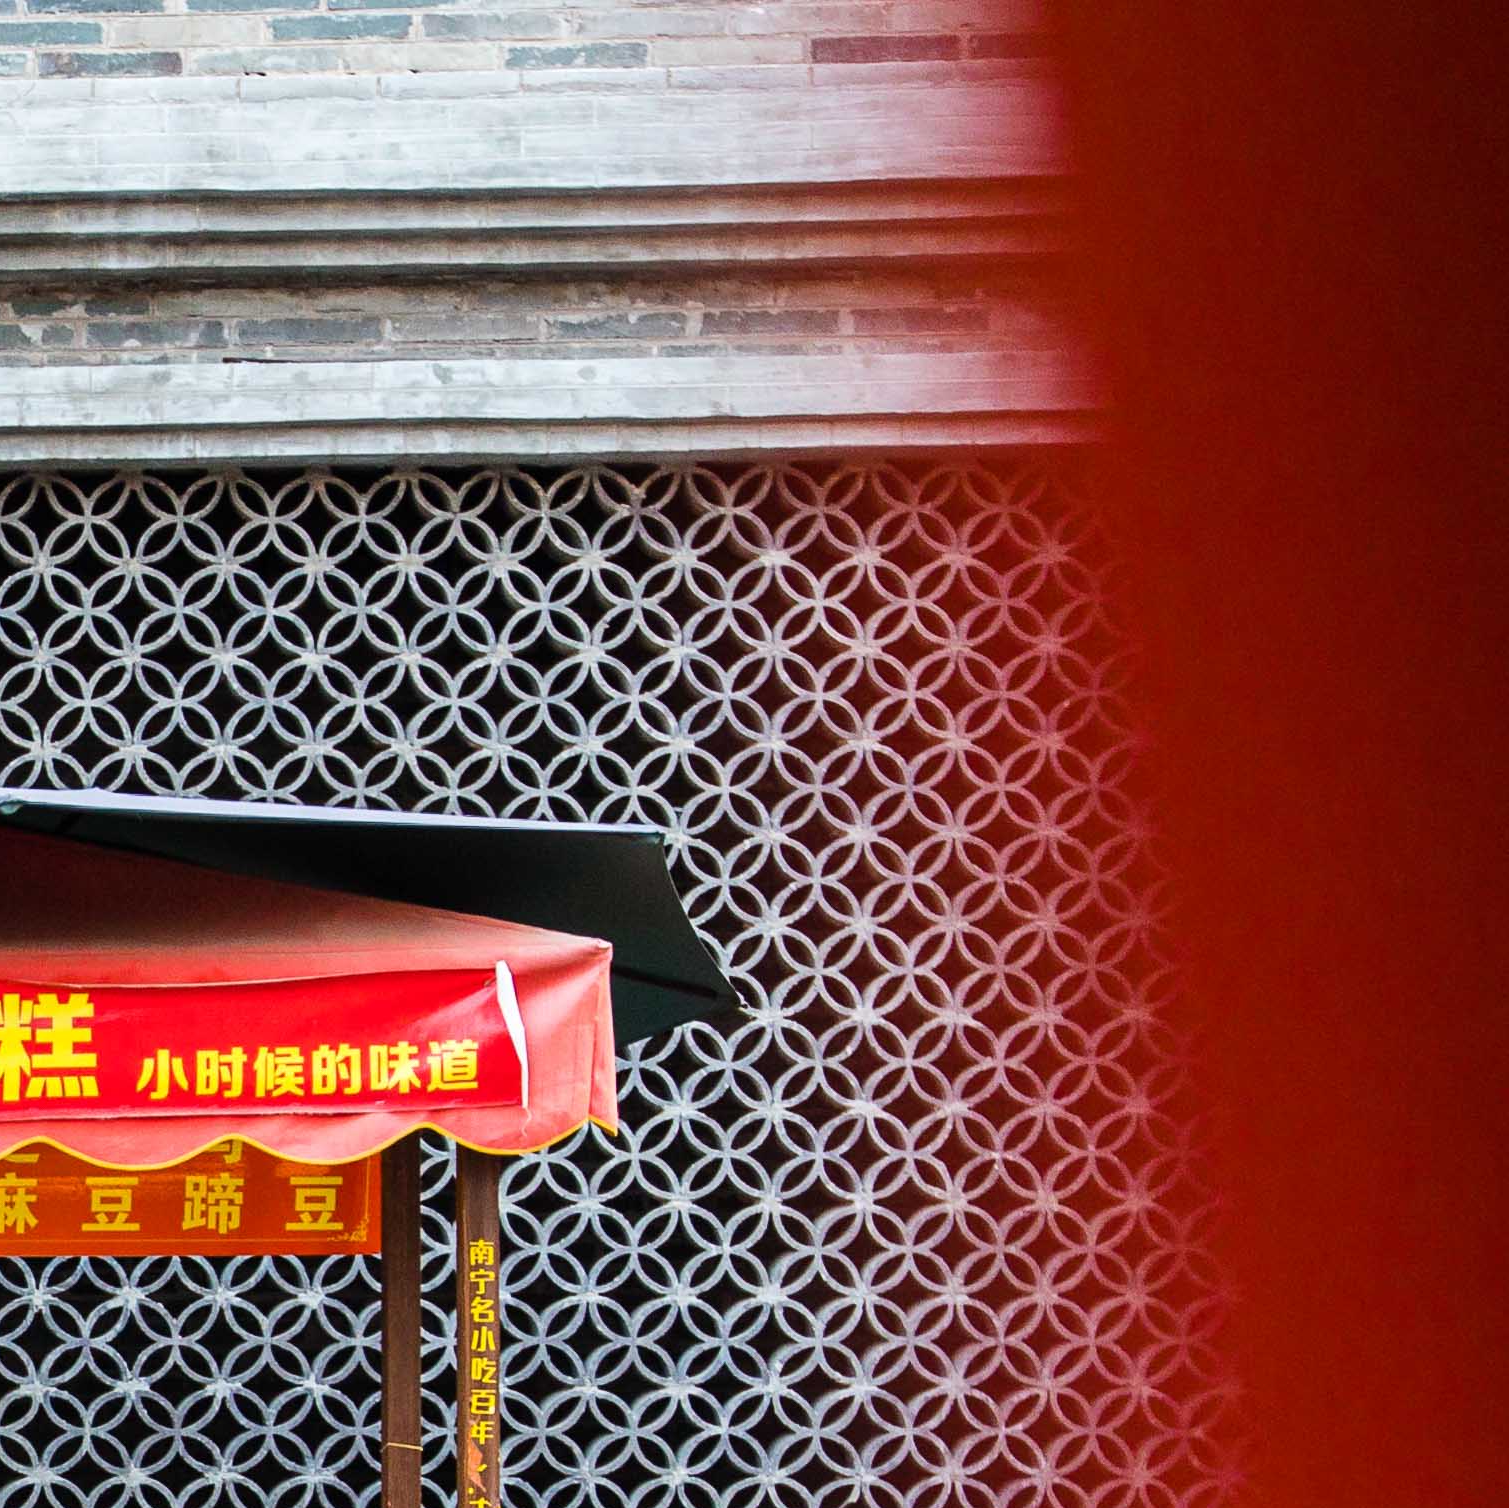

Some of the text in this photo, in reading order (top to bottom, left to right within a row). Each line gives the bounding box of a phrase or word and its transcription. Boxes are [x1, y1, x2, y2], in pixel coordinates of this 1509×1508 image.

[137, 1040, 479, 1100] 小时候的味道
